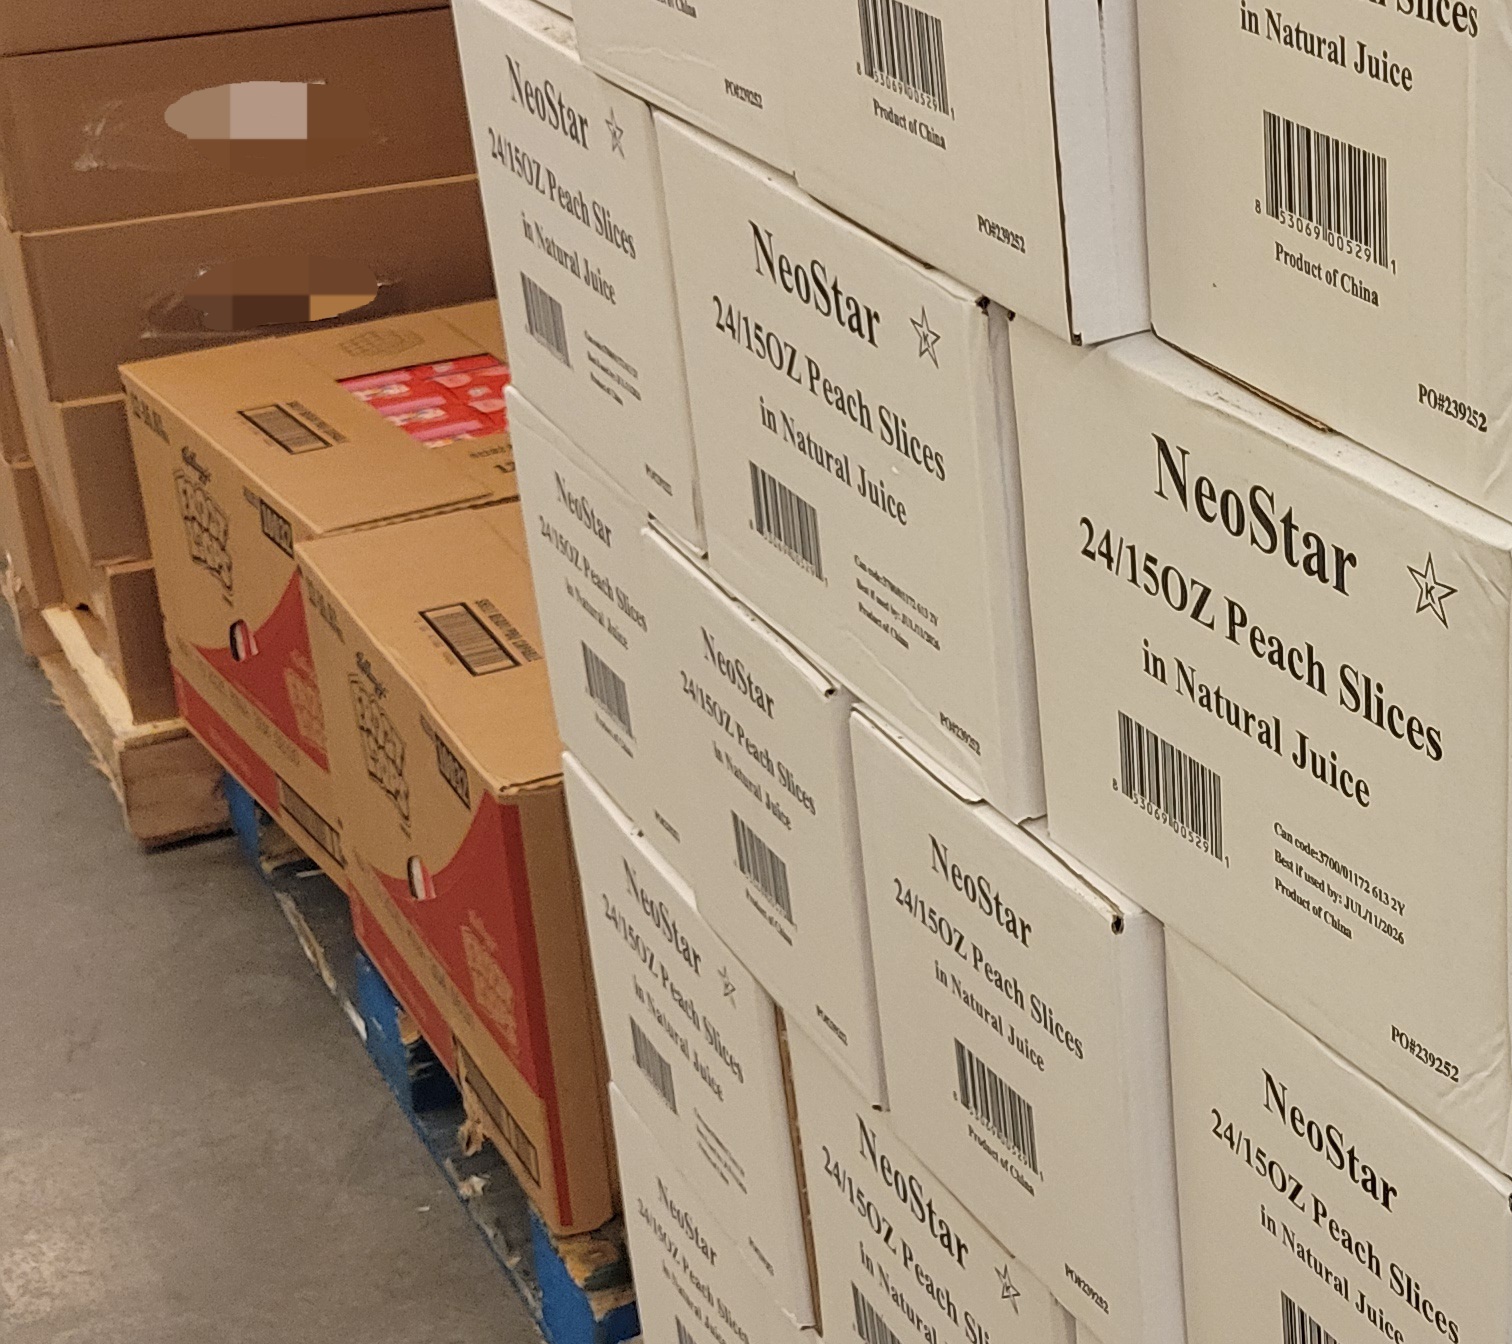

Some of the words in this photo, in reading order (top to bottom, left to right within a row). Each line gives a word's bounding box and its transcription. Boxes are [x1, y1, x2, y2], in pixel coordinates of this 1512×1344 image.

[1241, 0, 1259, 35] in
[1265, 8, 1346, 68] Natural
[1354, 41, 1412, 91] Juice
[1152, 433, 1357, 596] NeoStar
[1080, 517, 1214, 630] 24/15OZ
[1224, 596, 1327, 696] Peach
[1340, 664, 1442, 761] Slices
[1143, 639, 1167, 685] in
[1174, 658, 1282, 756] Natural
[1292, 730, 1369, 807] Juice
[1262, 1068, 1397, 1212] NeoStar
[1212, 1109, 1305, 1212] 24/15OZ
[1312, 1194, 1381, 1279] Peach
[1390, 1263, 1458, 1344] Slices
